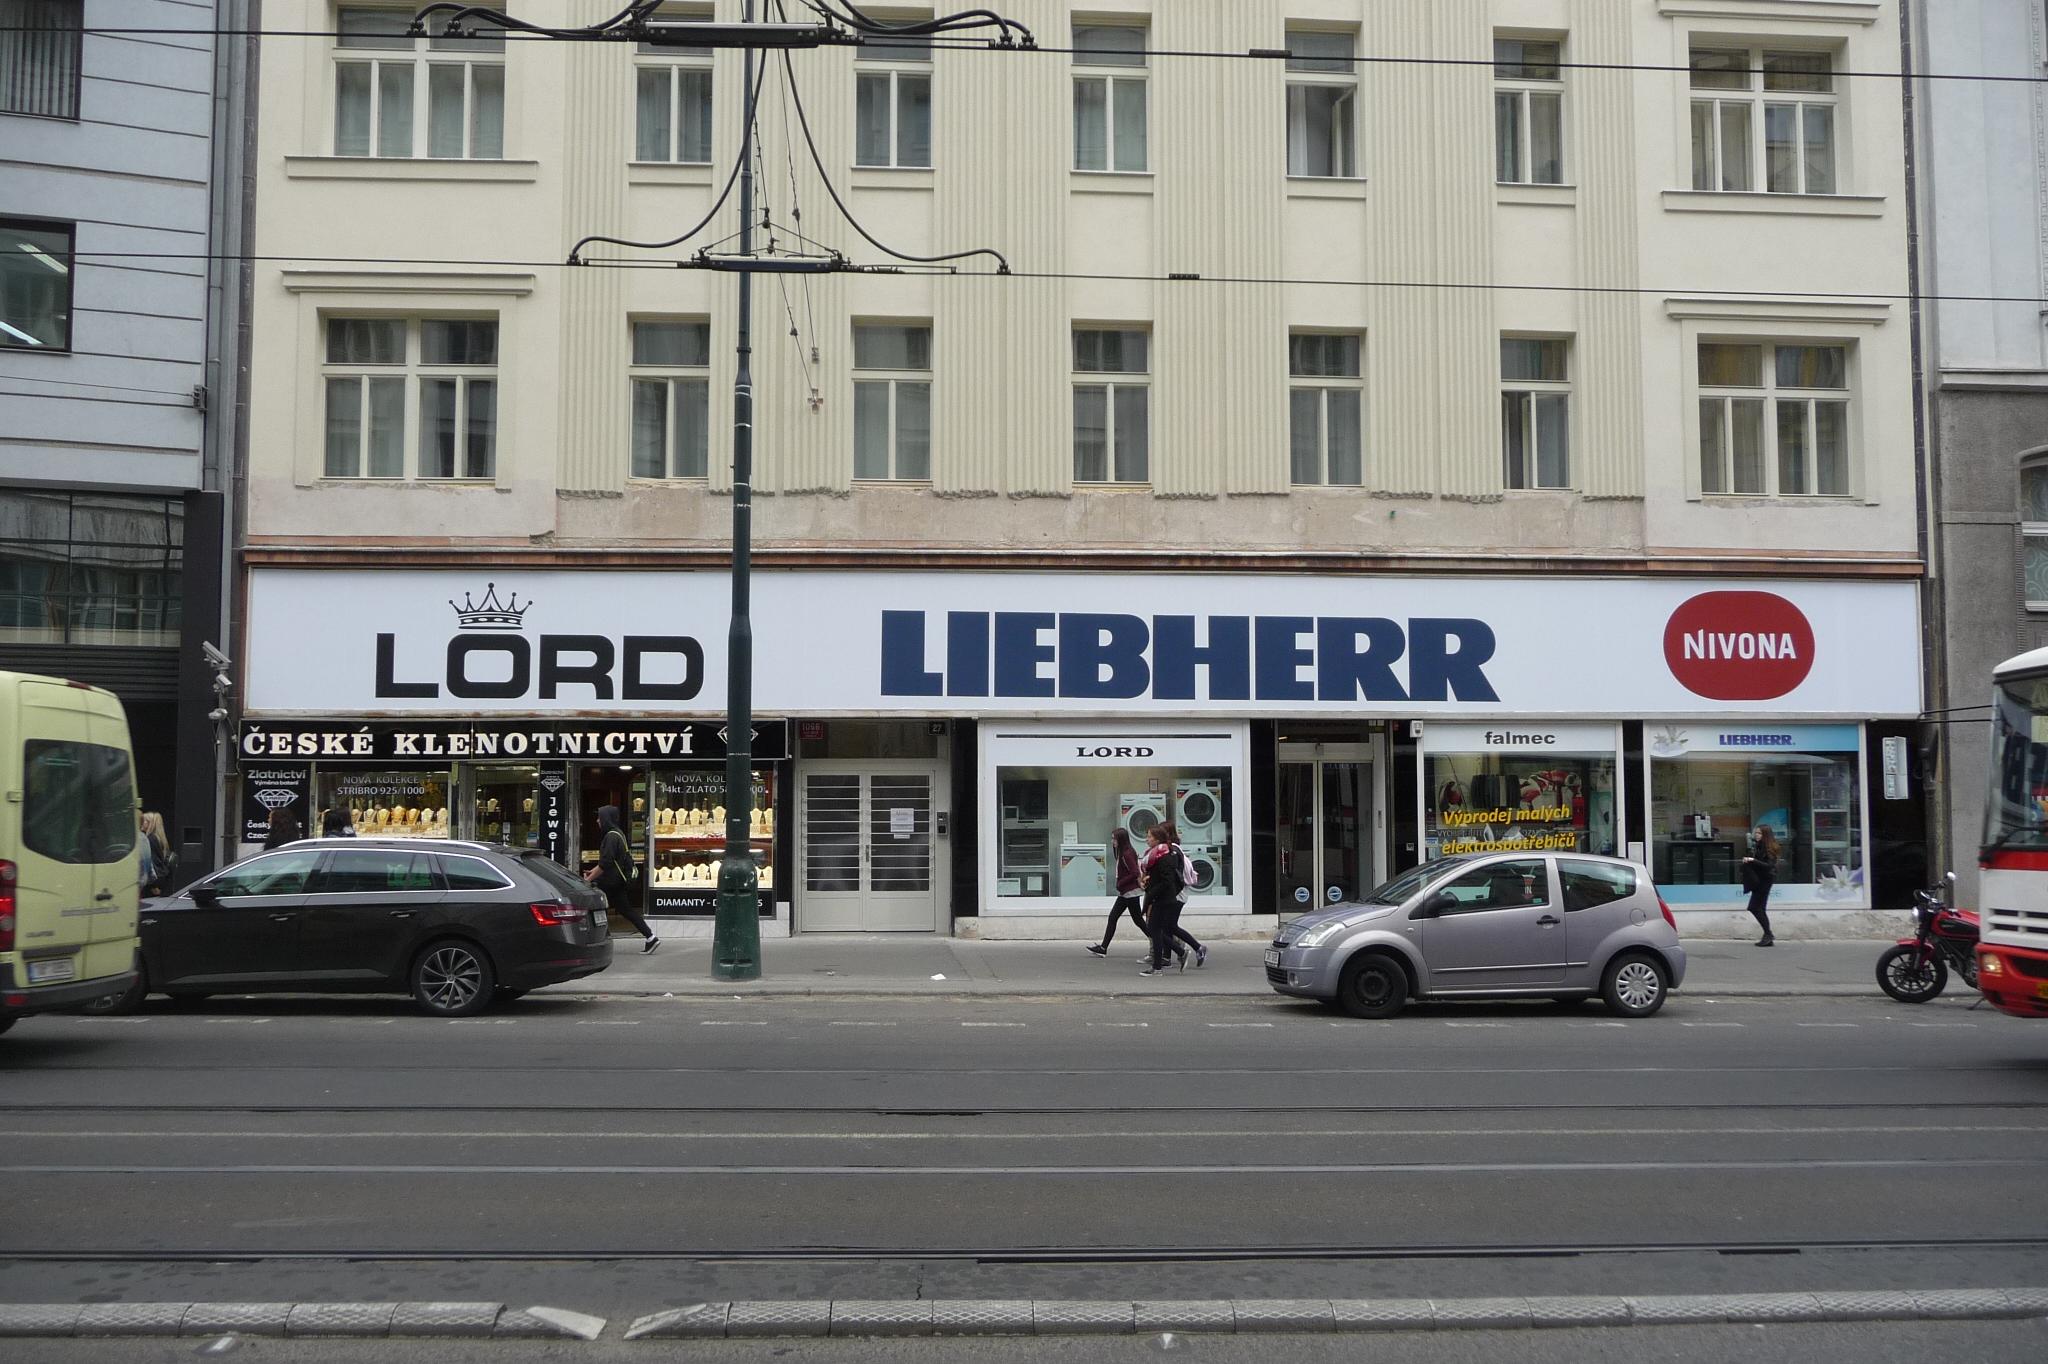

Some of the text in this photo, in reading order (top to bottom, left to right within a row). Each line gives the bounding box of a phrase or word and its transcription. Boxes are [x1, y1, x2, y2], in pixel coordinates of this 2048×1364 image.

[1683, 628, 1797, 659] NIVONA
[881, 609, 1500, 702] LIEBHERR
[375, 632, 704, 701] LORD
[932, 723, 942, 733] 27
[242, 725, 694, 755] ČESKÉ KLENOTNICTVÍ
[1484, 731, 1556, 745] falmec
[1719, 734, 1793, 746] LIEBHERR
[1076, 746, 1154, 758] LORD
[247, 769, 306, 779] Zlatnictví
[376, 776, 419, 784] KOLEKCE
[380, 786, 425, 795] 925/1000
[686, 785, 717, 793] ZLATO
[1443, 804, 1570, 826] Výprodej malých
[1442, 833, 1576, 855] elektrospotřebičů
[656, 898, 706, 907] DIAMANTY
